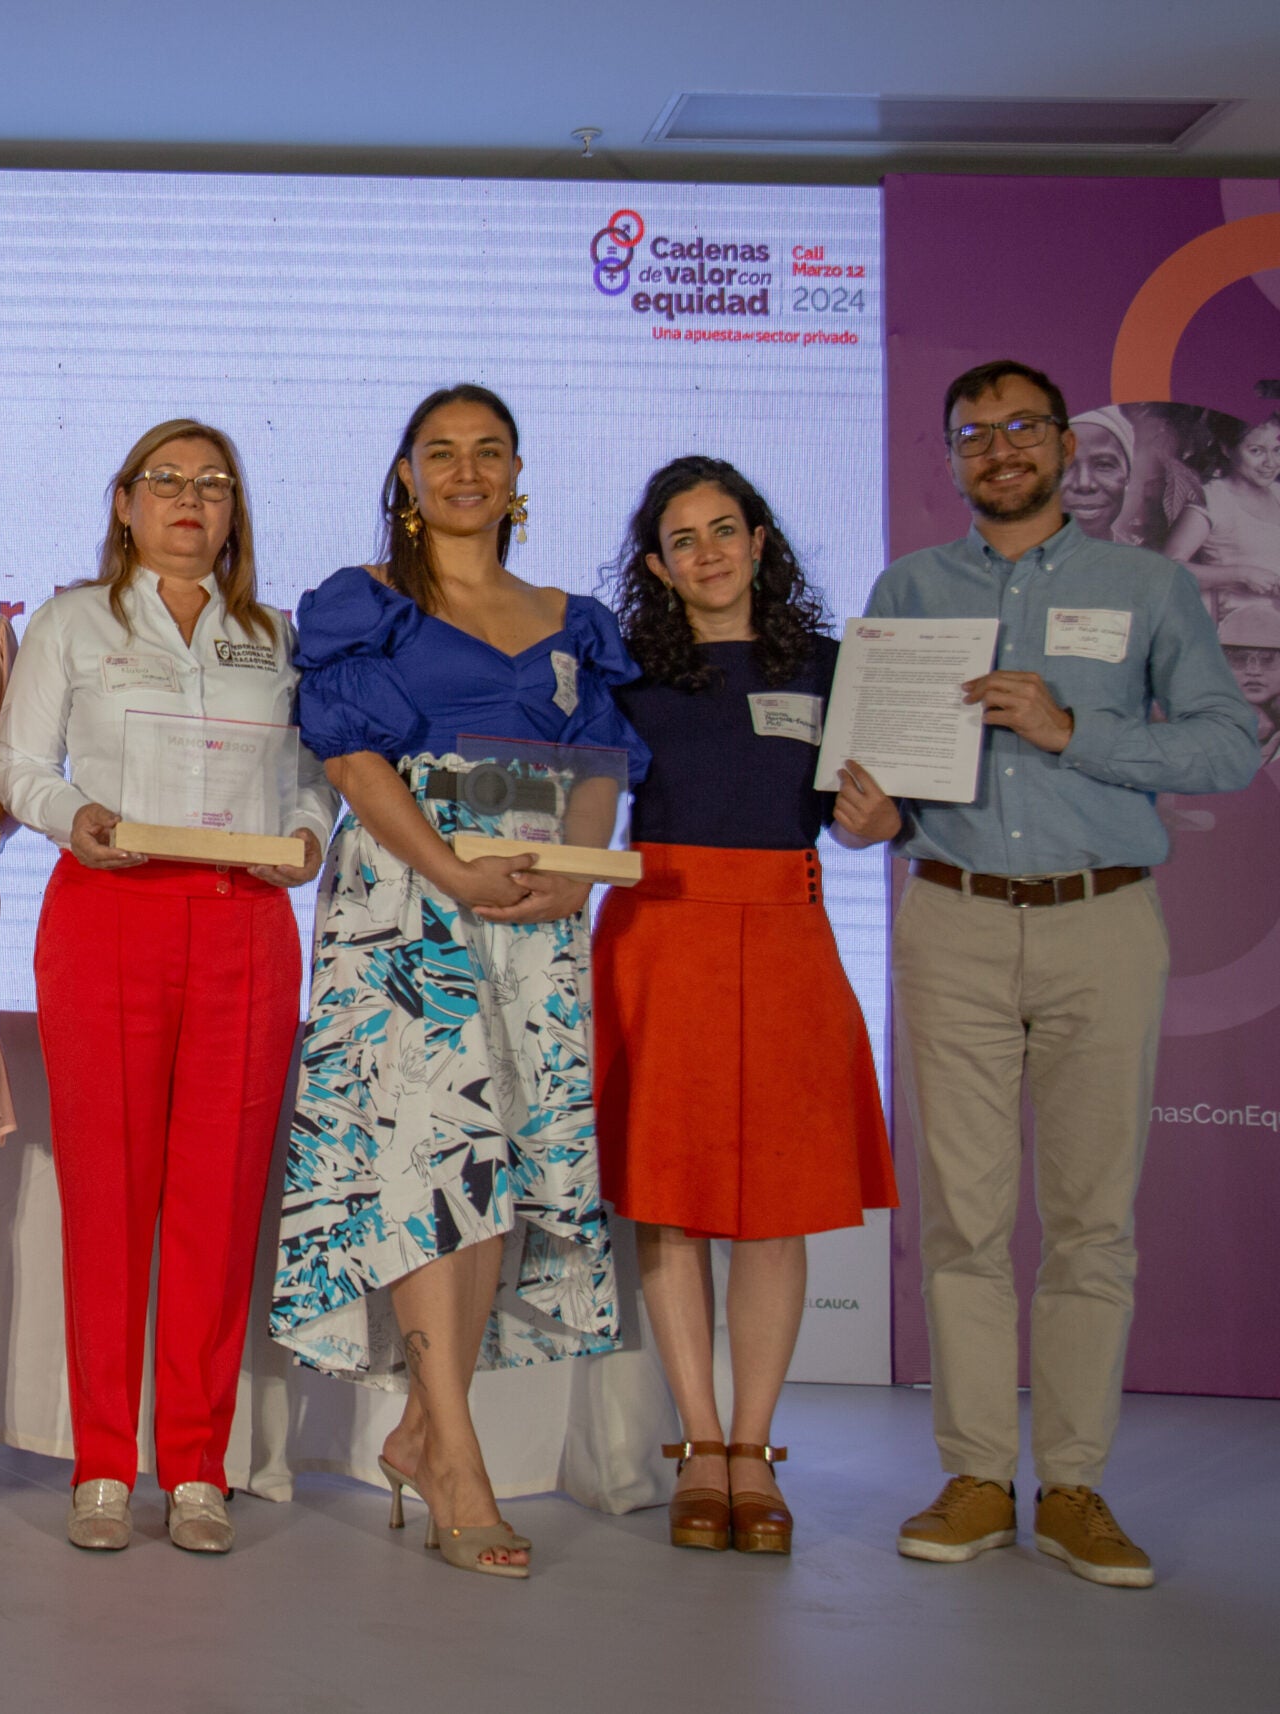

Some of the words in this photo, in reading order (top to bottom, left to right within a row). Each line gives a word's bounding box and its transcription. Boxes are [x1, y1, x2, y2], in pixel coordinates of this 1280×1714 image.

[650, 237, 770, 262] Cadenas
[792, 245, 824, 260] Cali
[638, 266, 662, 283] de
[664, 263, 737, 286] valor
[738, 269, 771, 286] con
[792, 263, 843, 277] Marzo
[846, 265, 865, 278] 12
[631, 288, 770, 321] equidad
[792, 286, 866, 312] 2024
[652, 326, 681, 340] Una
[684, 327, 742, 344] apuesta
[755, 329, 800, 343] sector
[803, 331, 858, 347] privado
